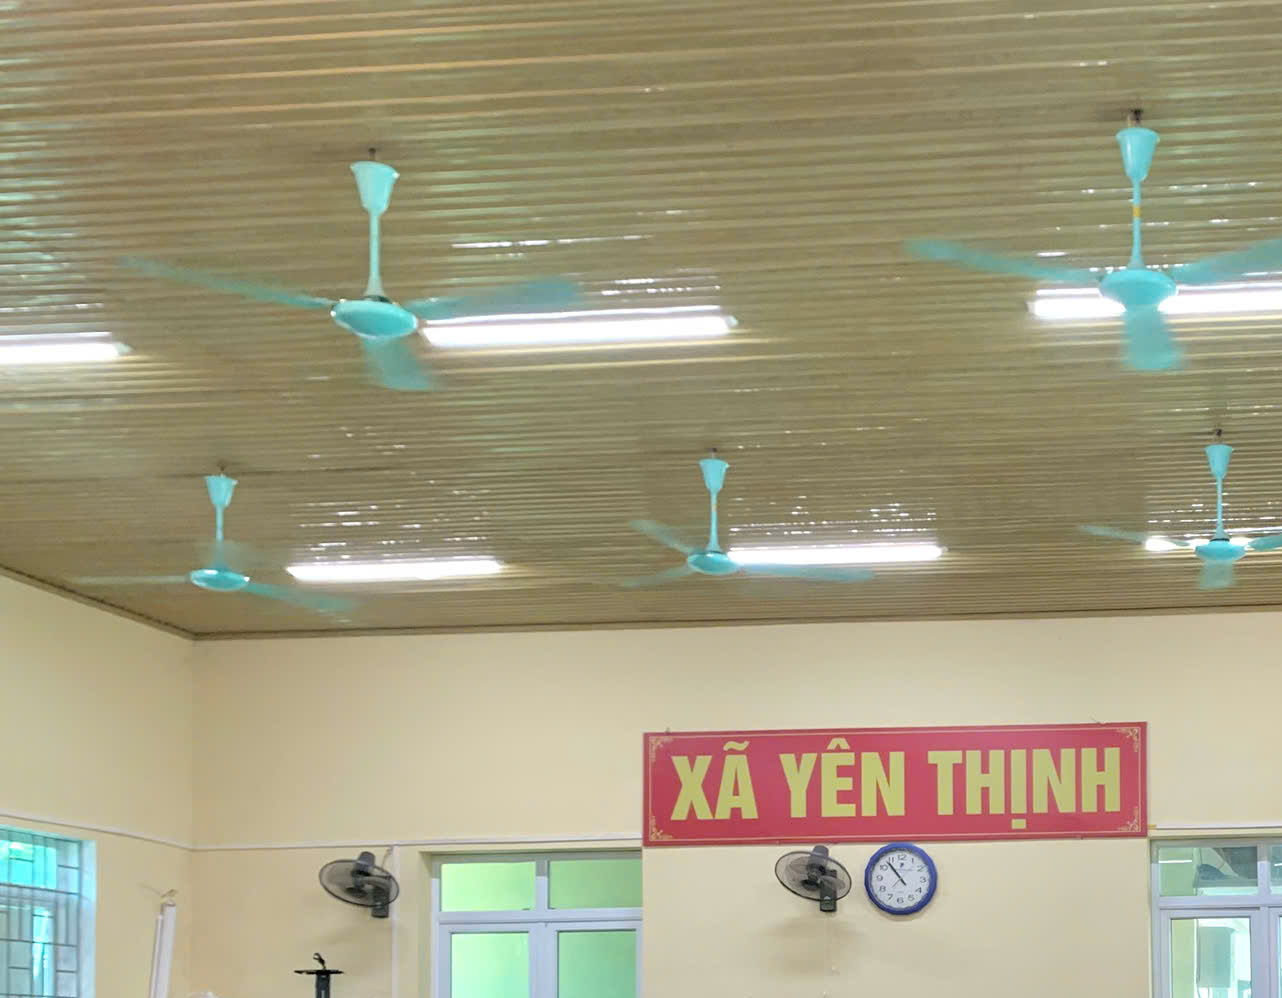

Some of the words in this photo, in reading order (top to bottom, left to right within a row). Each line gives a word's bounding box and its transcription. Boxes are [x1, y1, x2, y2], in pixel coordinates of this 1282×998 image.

[670, 740, 759, 821] XÃ
[779, 738, 906, 818] YÊN
[928, 746, 1121, 830] THỊNH
